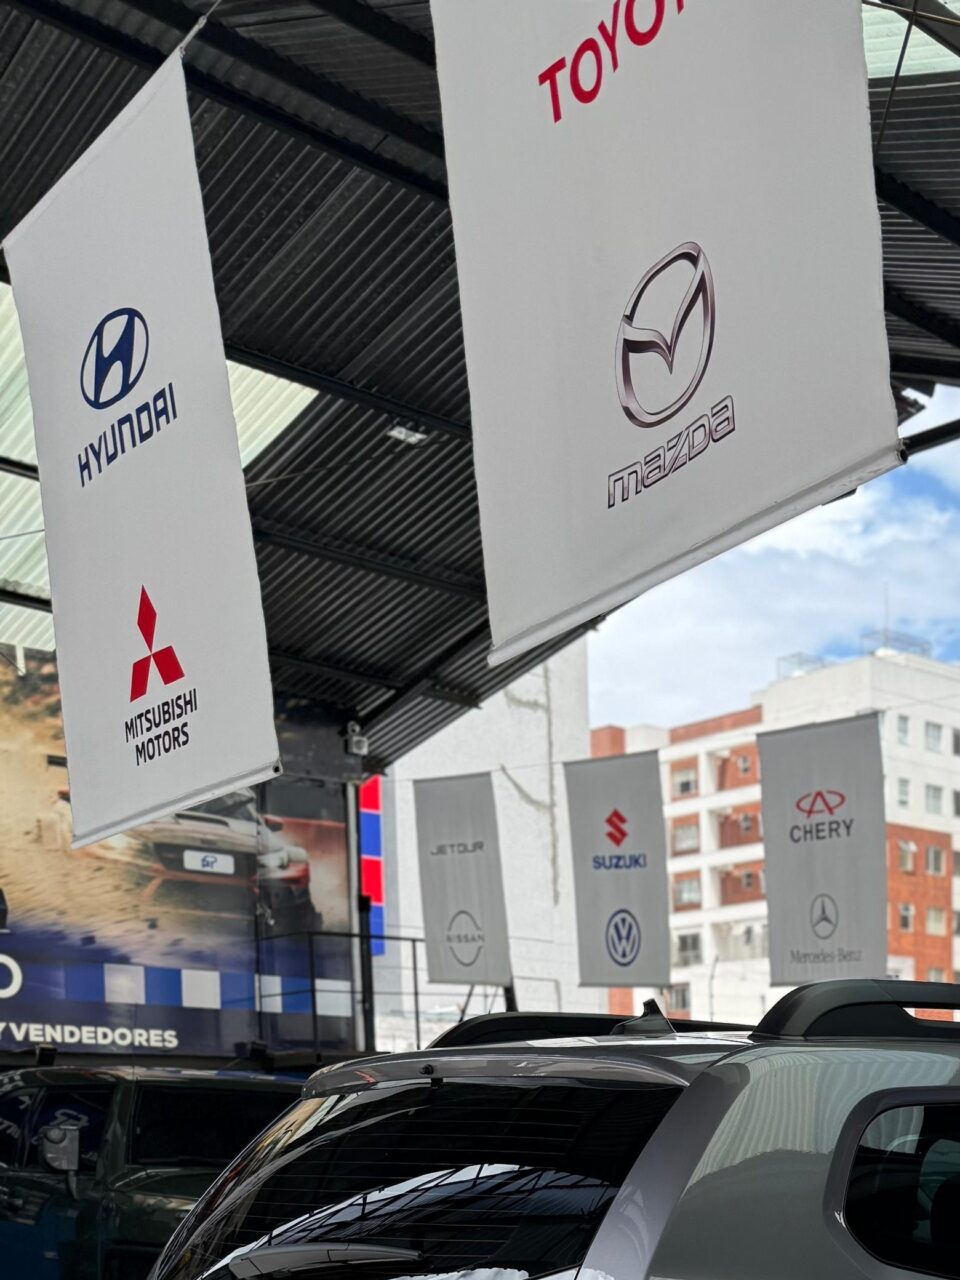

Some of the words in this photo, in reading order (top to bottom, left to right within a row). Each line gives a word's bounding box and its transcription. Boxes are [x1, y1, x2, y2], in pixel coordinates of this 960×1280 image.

[538, 0, 684, 123] TOYO
[78, 382, 178, 488] HYUNDAI
[125, 688, 197, 743] MITSUBISHI
[135, 721, 189, 766] MOTORS
[790, 818, 855, 843] CHERY
[430, 841, 484, 856] JETOUR
[592, 853, 647, 870] SUZUKI
[446, 933, 485, 944] NISSAN
[790, 948, 862, 964] Mercedes-Benz
[9, 1022, 179, 1048] VENDEDORES
